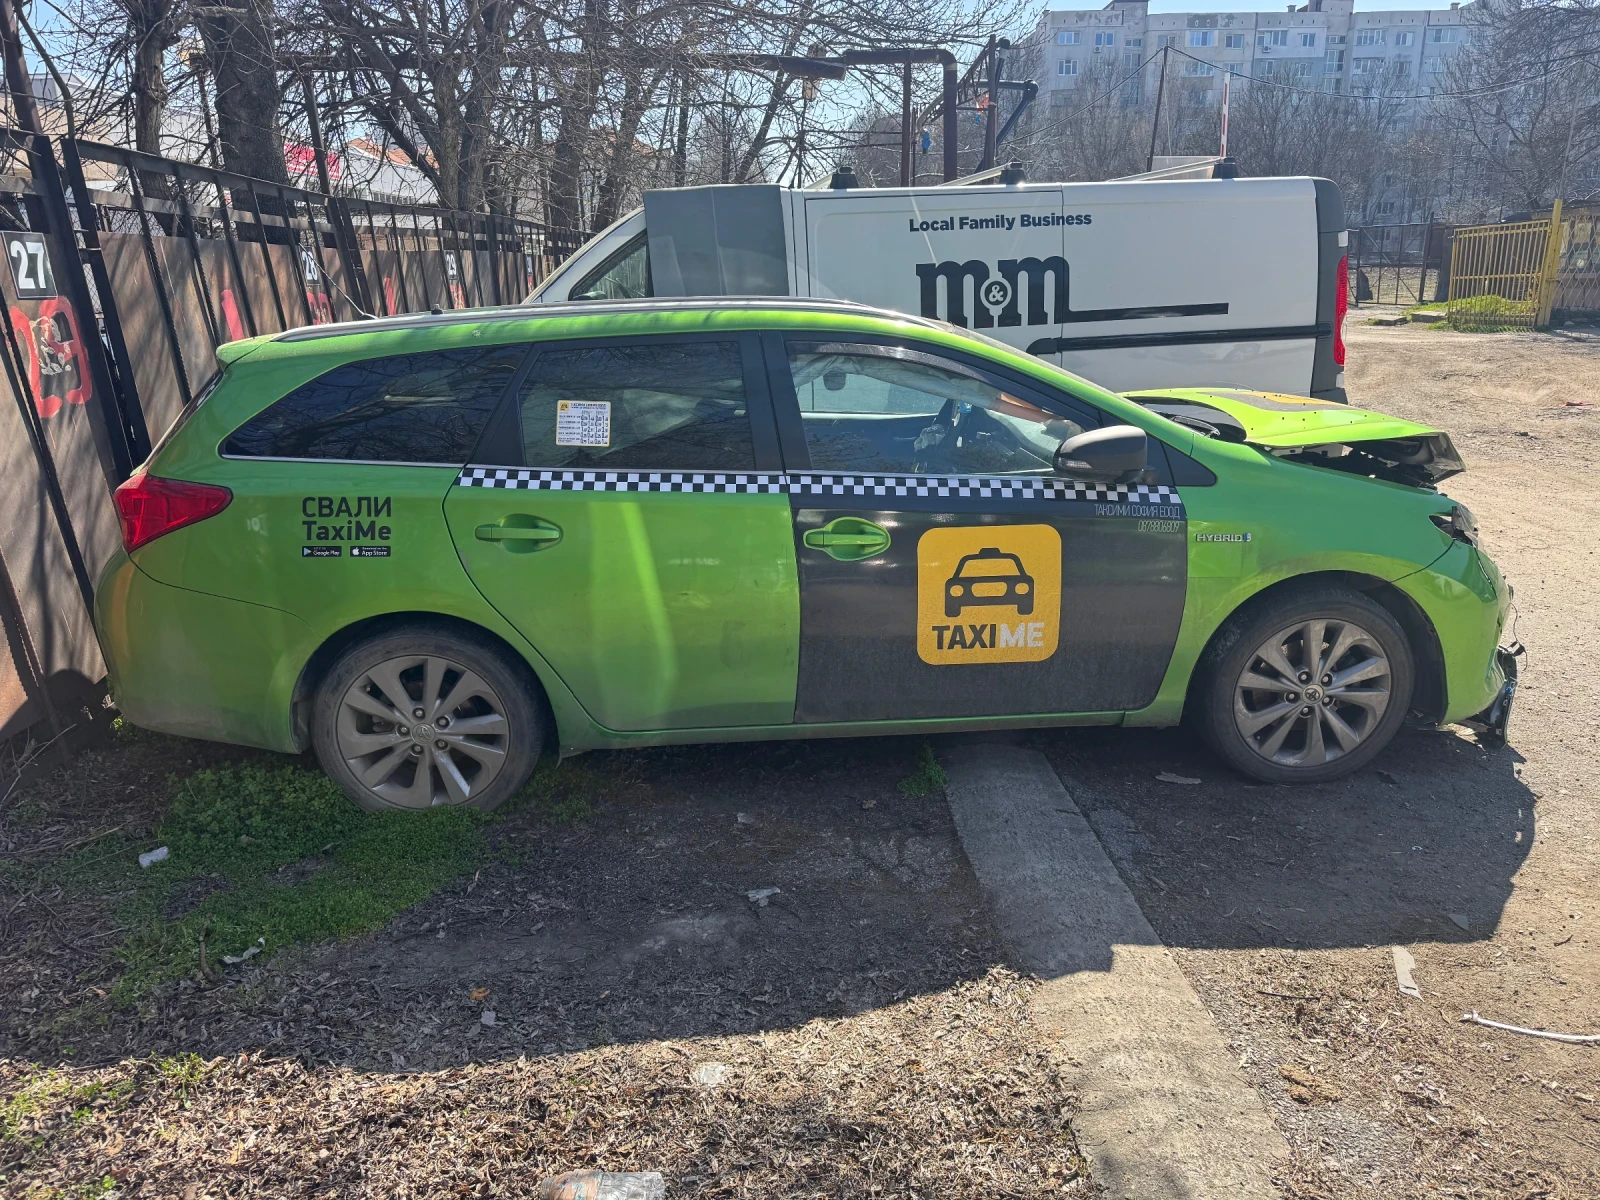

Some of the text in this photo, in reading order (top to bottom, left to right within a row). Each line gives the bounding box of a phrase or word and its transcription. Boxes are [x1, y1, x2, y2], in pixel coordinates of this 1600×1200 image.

[909, 212, 1092, 233] Local Family Business
[9, 240, 47, 290] 27
[301, 496, 392, 518] СВАЛИ
[1094, 503, 1181, 520] ТАКСИМИ СОФИЯ ЕООД
[301, 519, 392, 541] TaxiMe
[1196, 533, 1243, 542] HYBRID
